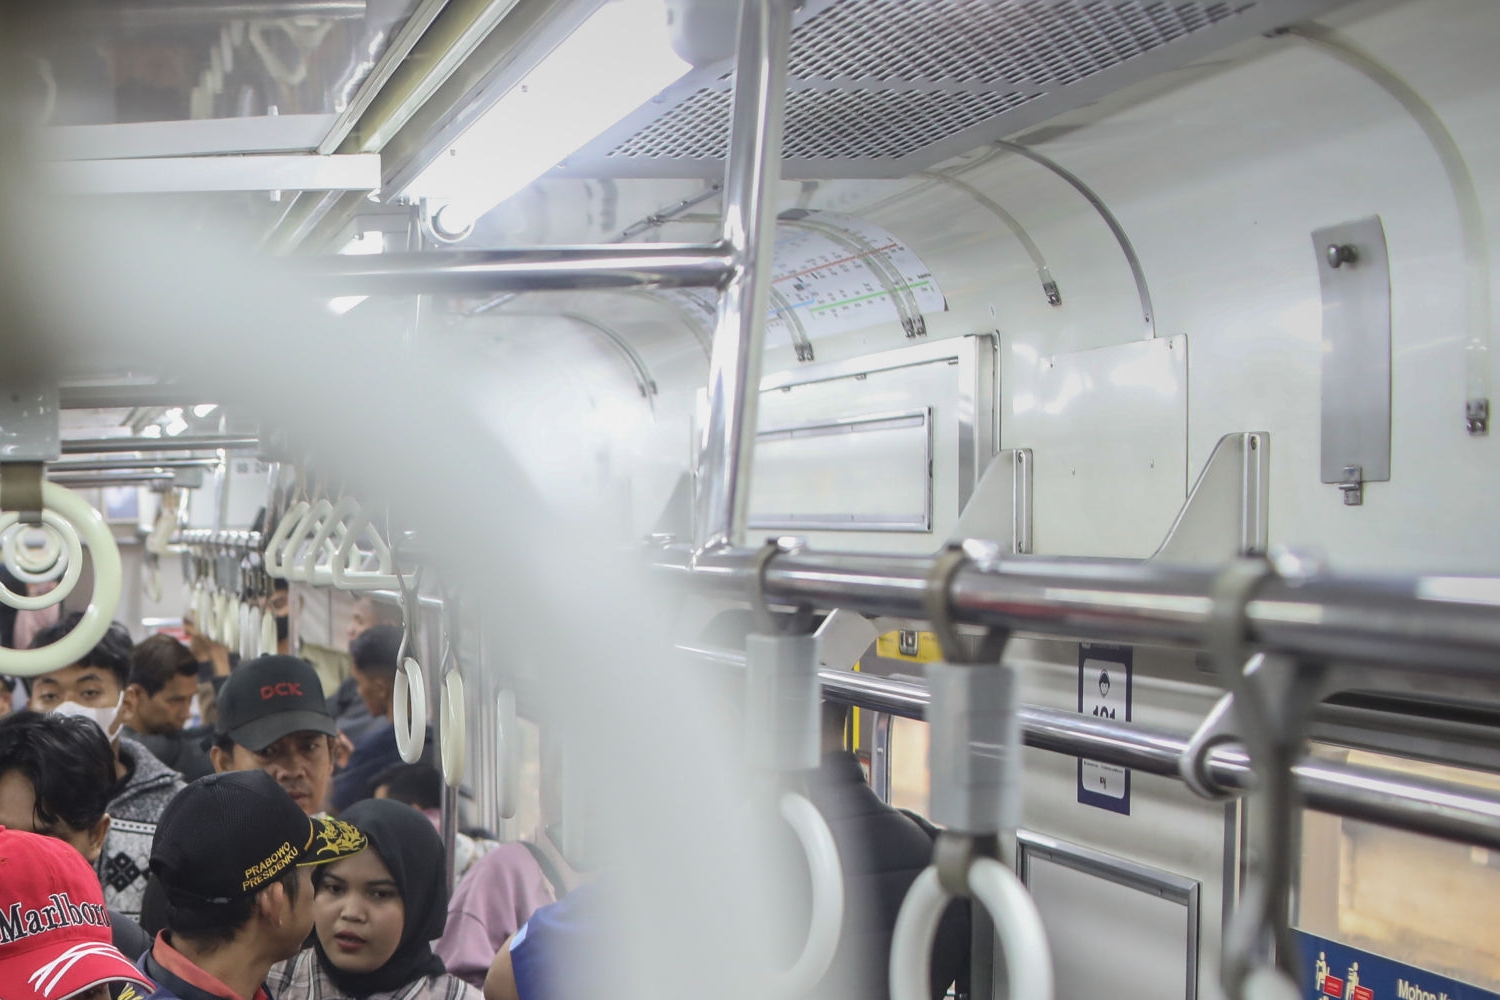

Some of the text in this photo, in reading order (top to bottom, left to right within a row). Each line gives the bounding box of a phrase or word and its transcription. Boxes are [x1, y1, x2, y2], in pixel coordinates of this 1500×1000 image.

[260, 682, 303, 699] DCK
[242, 846, 298, 891] PRESIDENKU
[245, 841, 290, 879] PRABOWO
